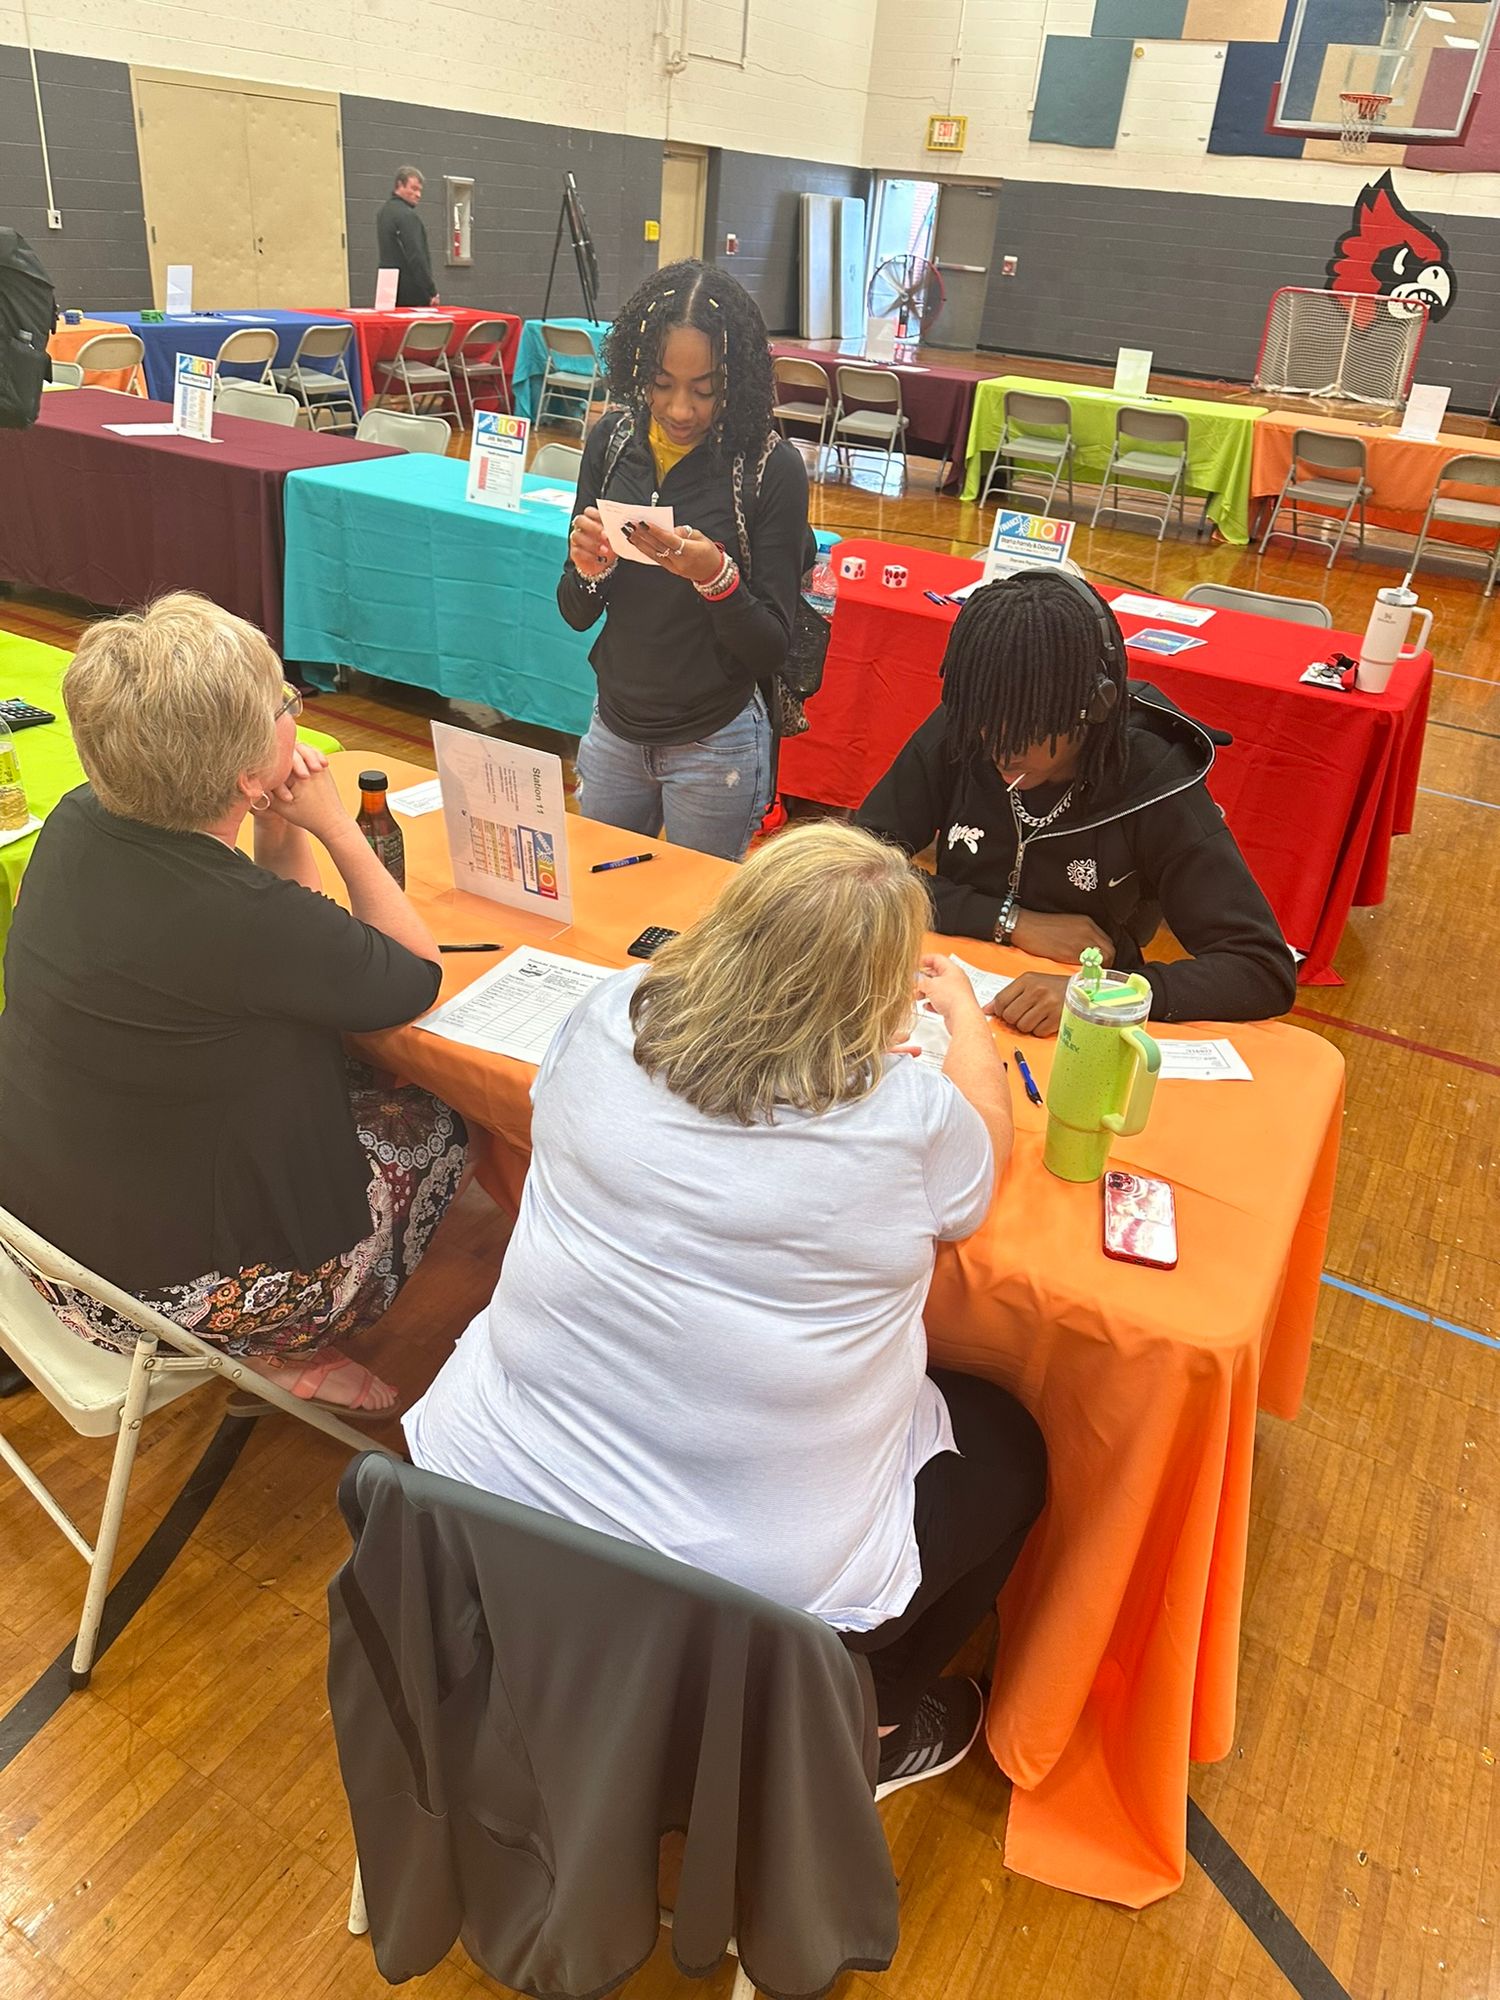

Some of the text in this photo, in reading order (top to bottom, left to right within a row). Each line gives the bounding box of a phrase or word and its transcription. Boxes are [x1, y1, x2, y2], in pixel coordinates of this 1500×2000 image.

[939, 122, 954, 137] EXIT
[500, 418, 525, 438] 101
[1033, 520, 1067, 541] 101
[1016, 539, 1033, 549] Family
[1037, 543, 1059, 552] Daycare
[532, 766, 545, 816] Station 11
[527, 840, 536, 882] Entertainment
[539, 864, 557, 898] 101
